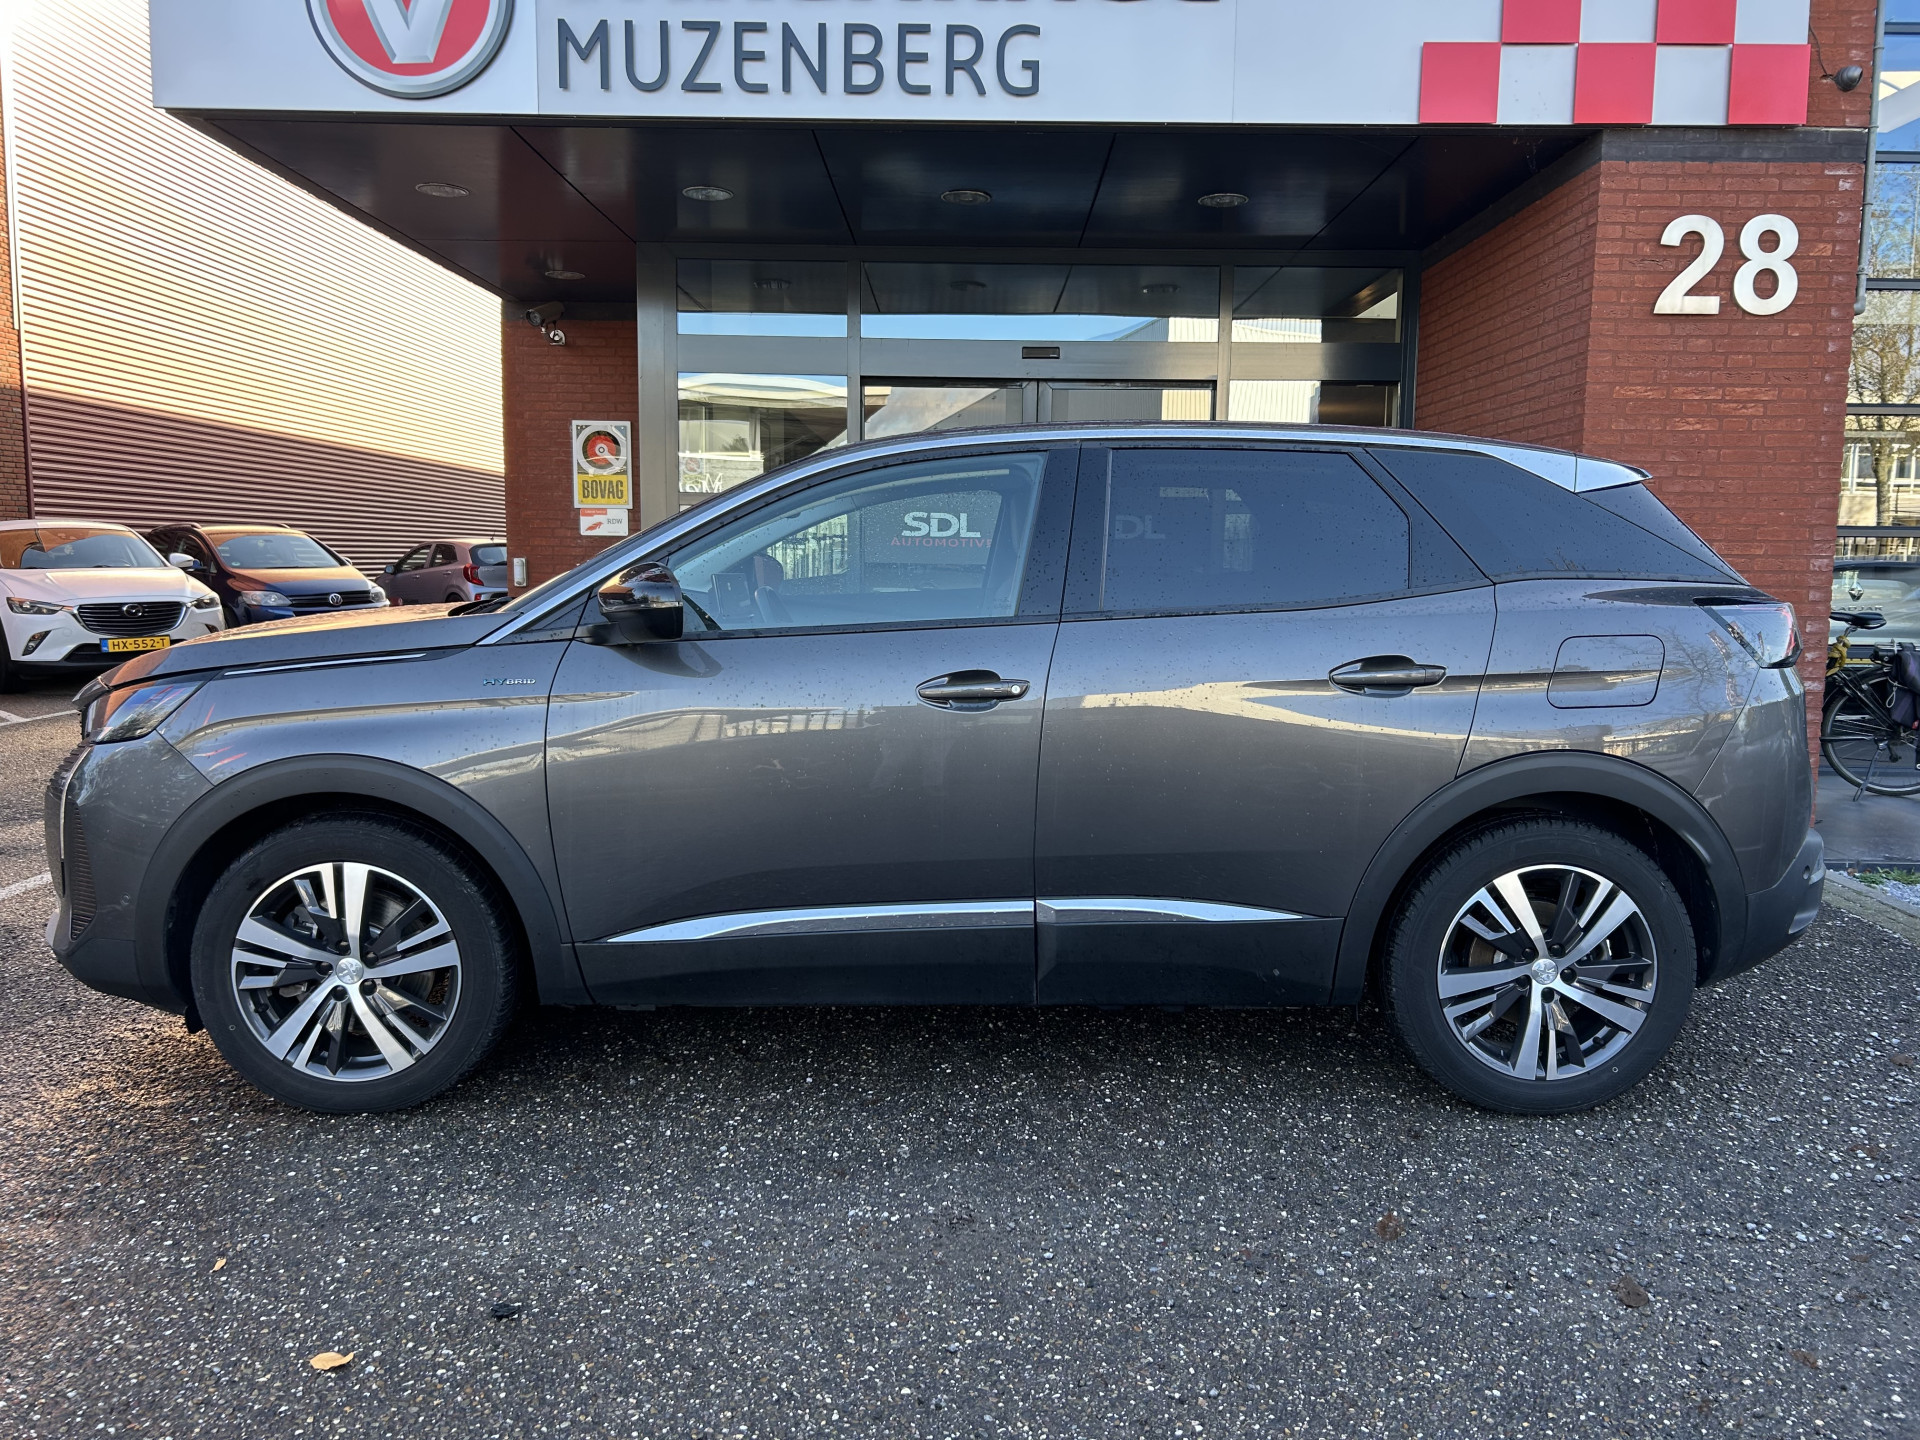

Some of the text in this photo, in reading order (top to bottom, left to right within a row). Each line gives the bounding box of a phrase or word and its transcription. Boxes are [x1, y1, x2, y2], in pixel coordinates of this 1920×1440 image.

[557, 18, 1041, 97] MUZENBERG
[1653, 213, 1799, 316] 28
[581, 479, 624, 500] BOVAG
[901, 511, 981, 537] SDL
[112, 638, 167, 651] HX-552-T
[483, 678, 536, 686] HYBRID
